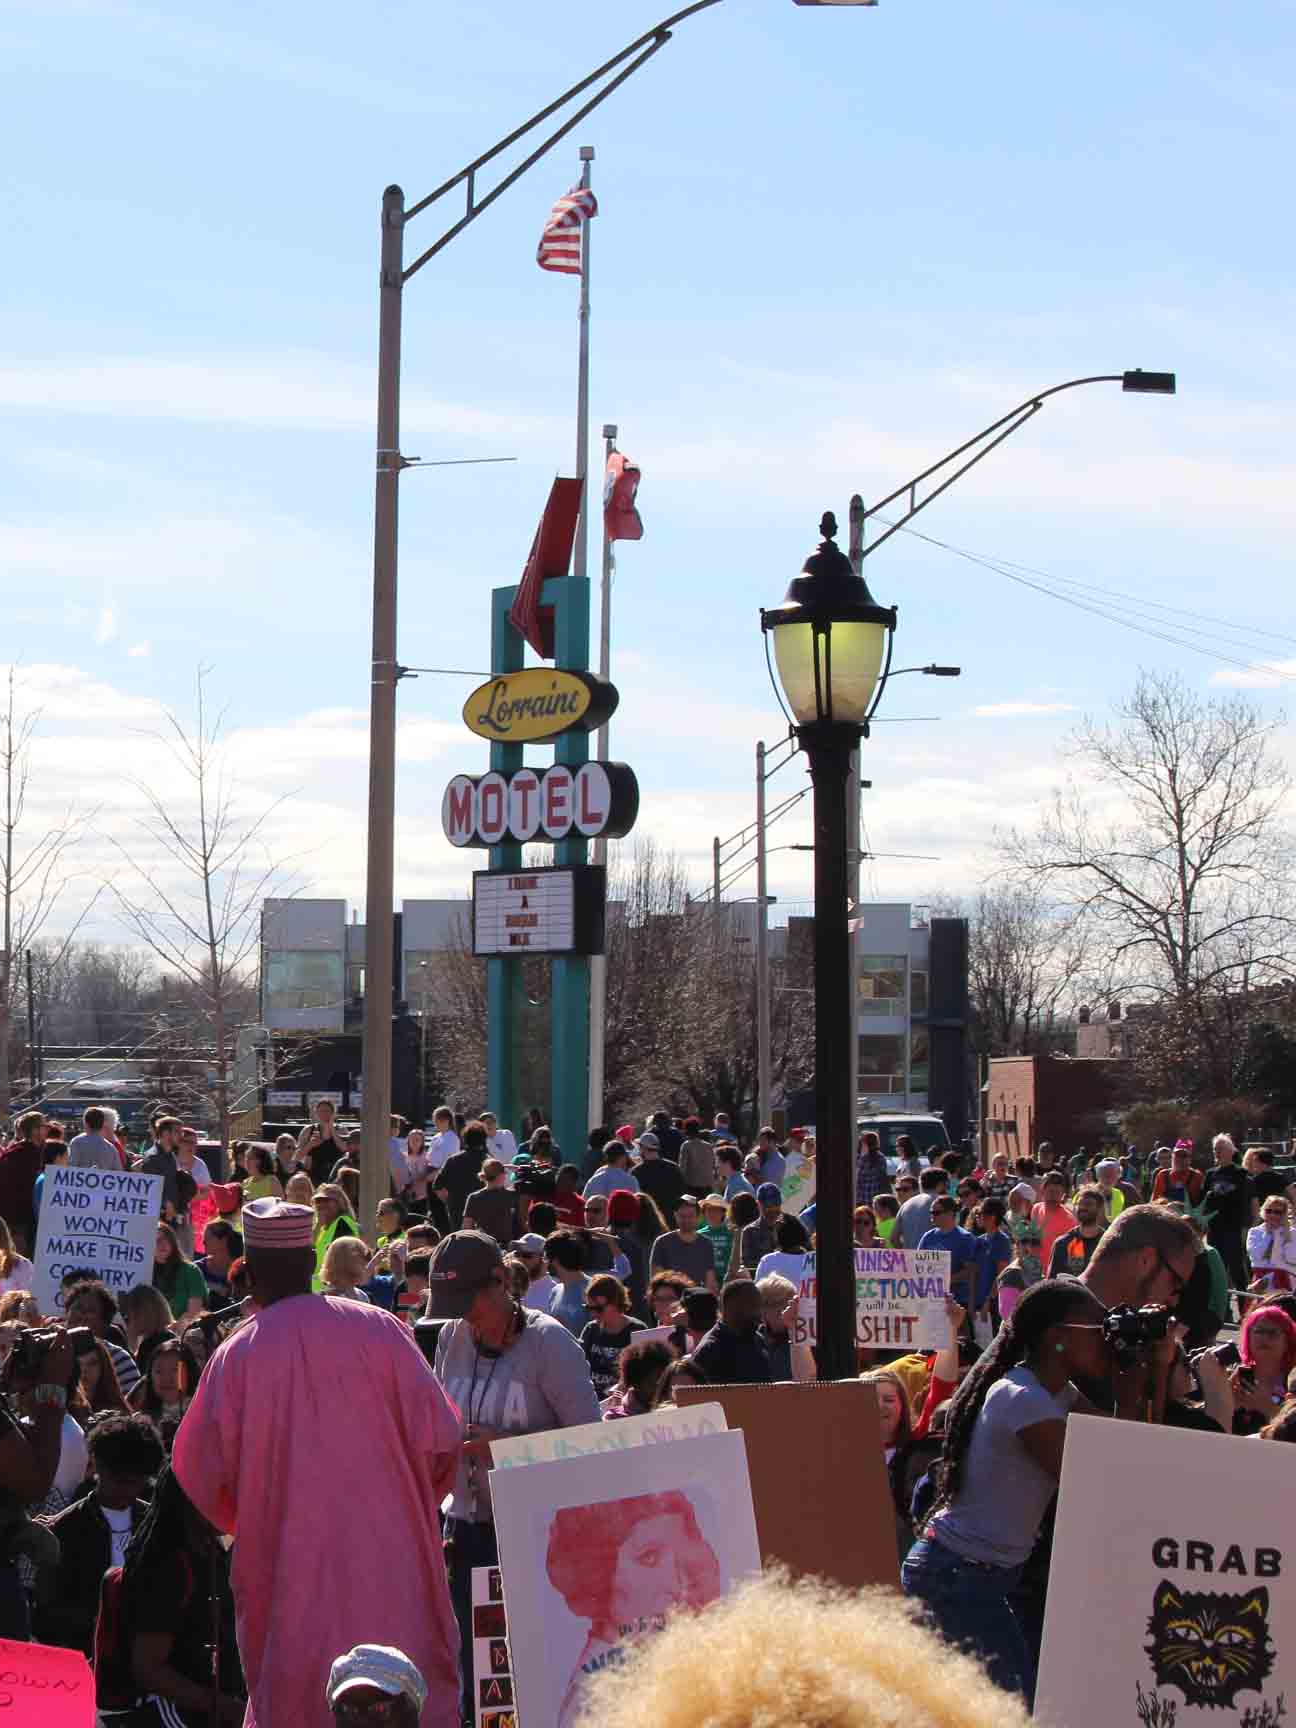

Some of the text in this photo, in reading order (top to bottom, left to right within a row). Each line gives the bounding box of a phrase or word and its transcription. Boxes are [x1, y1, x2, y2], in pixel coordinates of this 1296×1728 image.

[477, 680, 579, 733] Lorraine
[449, 773, 603, 836] MOTEL
[54, 1170, 153, 1195] MISOGYNY
[50, 1191, 148, 1215] AND HATE
[64, 1215, 128, 1236] WON'T
[46, 1238, 144, 1263] MAKE THIS
[1151, 1537, 1282, 1577] GRAB
